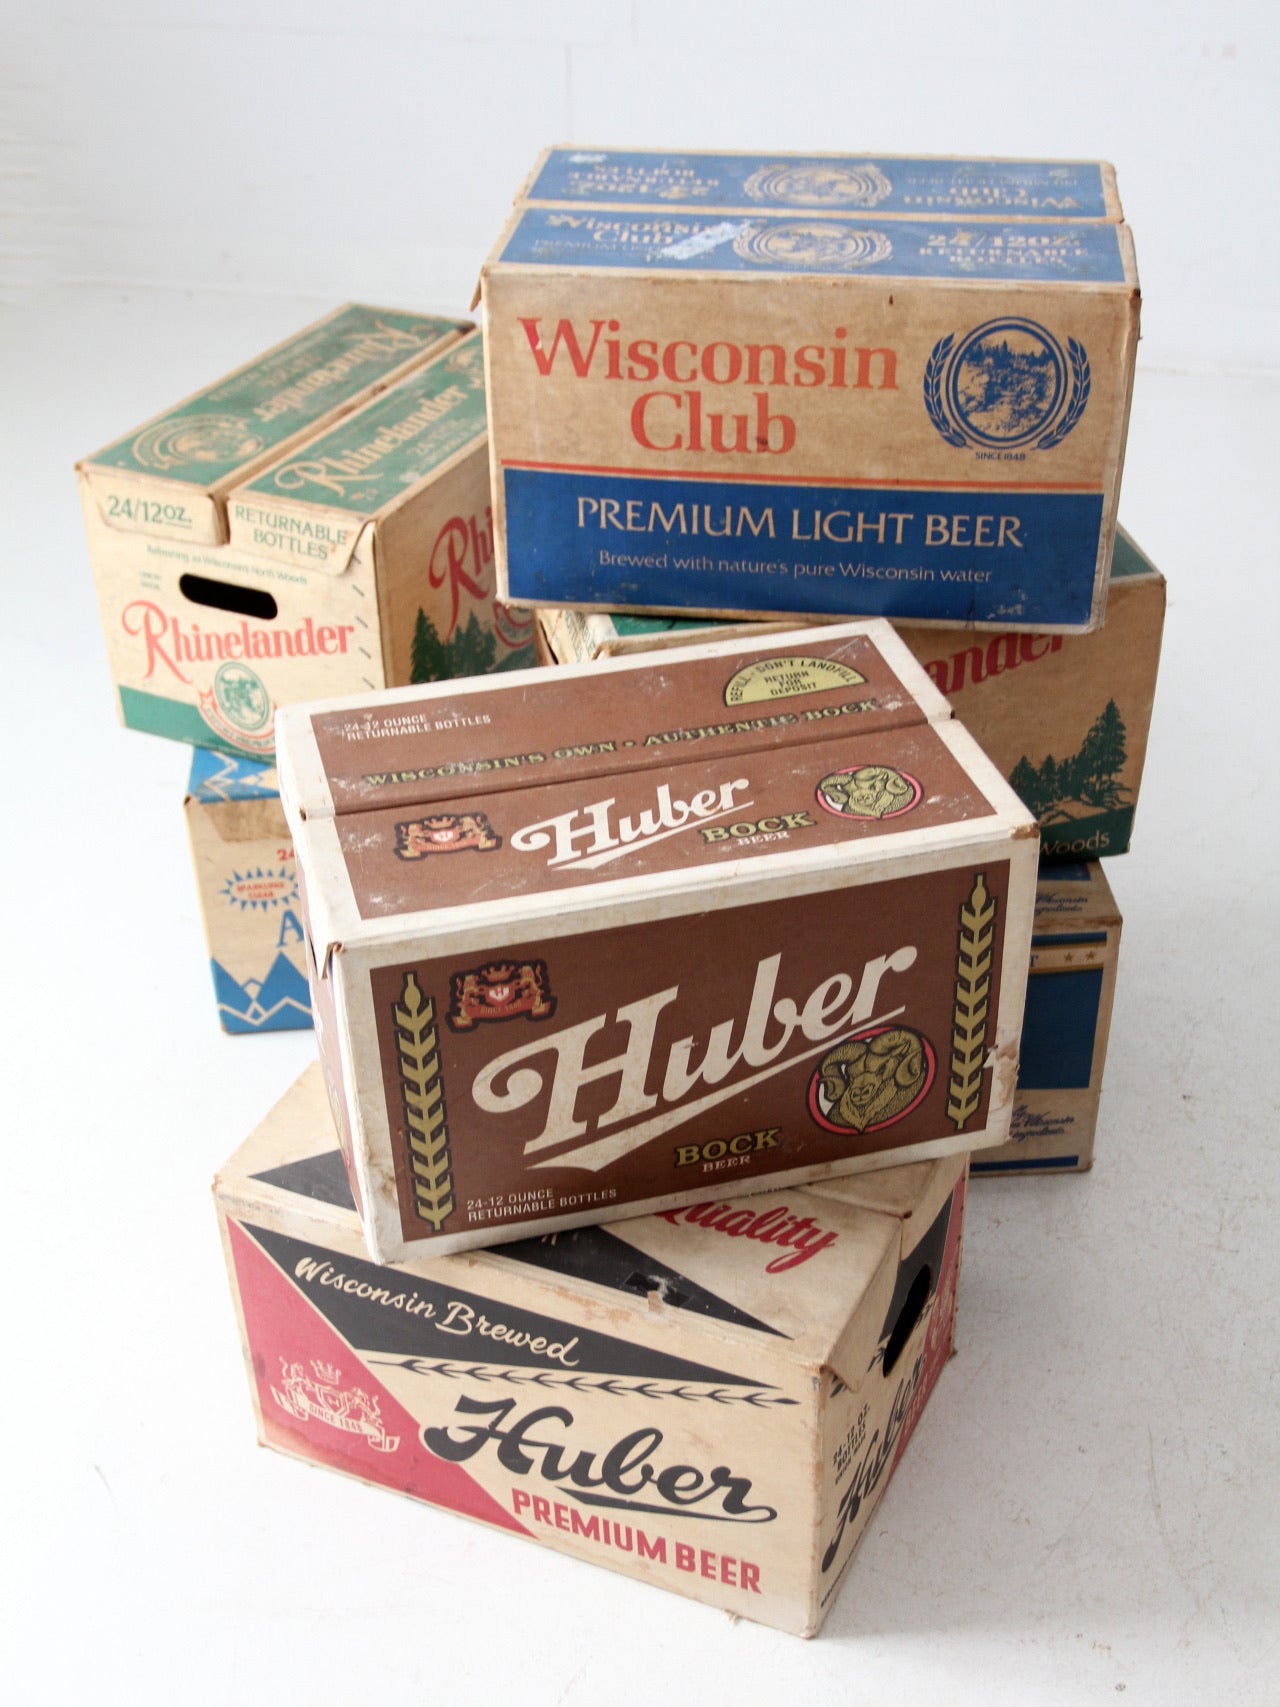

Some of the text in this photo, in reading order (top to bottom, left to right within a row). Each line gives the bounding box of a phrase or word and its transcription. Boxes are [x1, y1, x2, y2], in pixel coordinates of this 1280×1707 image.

[517, 316, 898, 391] Wisconsin
[275, 385, 469, 497] Rhinelander
[630, 389, 796, 454] Club
[976, 451, 1001, 461] SINCE
[234, 506, 348, 546] RETURNABLE
[576, 497, 1024, 549] PREMIUM LIGHT BEER
[253, 528, 330, 560] BOTTLES
[599, 549, 993, 585] Brewed with nature's pure Wisconsin water
[122, 599, 354, 683] Rhinelander
[755, 659, 794, 673] DON'T
[800, 660, 857, 683] LANDFILL
[764, 670, 809, 684] RETURN
[770, 682, 817, 696] DEPOSIT
[779, 678, 802, 688] FOR
[345, 714, 491, 741] RETURNABLE BOTTLES
[383, 713, 427, 728] OUNCE
[364, 698, 882, 787] WISCONSIN'S OWN AUTHENTIC BOCK
[510, 778, 750, 868] Huber
[698, 810, 818, 845] BOCK
[737, 830, 790, 847] BEER
[471, 945, 918, 1160] Huber
[674, 1125, 783, 1168] BOCK
[702, 1154, 752, 1172] BEER
[466, 1187, 554, 1211] 24-12 OUNCE
[467, 1188, 617, 1223] RETURNABLE BOTTLES
[652, 1200, 839, 1274] uality
[294, 1256, 580, 1367] Wisconsin Brewed
[423, 1394, 778, 1523] Huber
[820, 1354, 926, 1574] Huber
[837, 1418, 867, 1472] BOTTLES
[511, 1487, 668, 1565] PREMIUM
[675, 1541, 763, 1595] BEER
